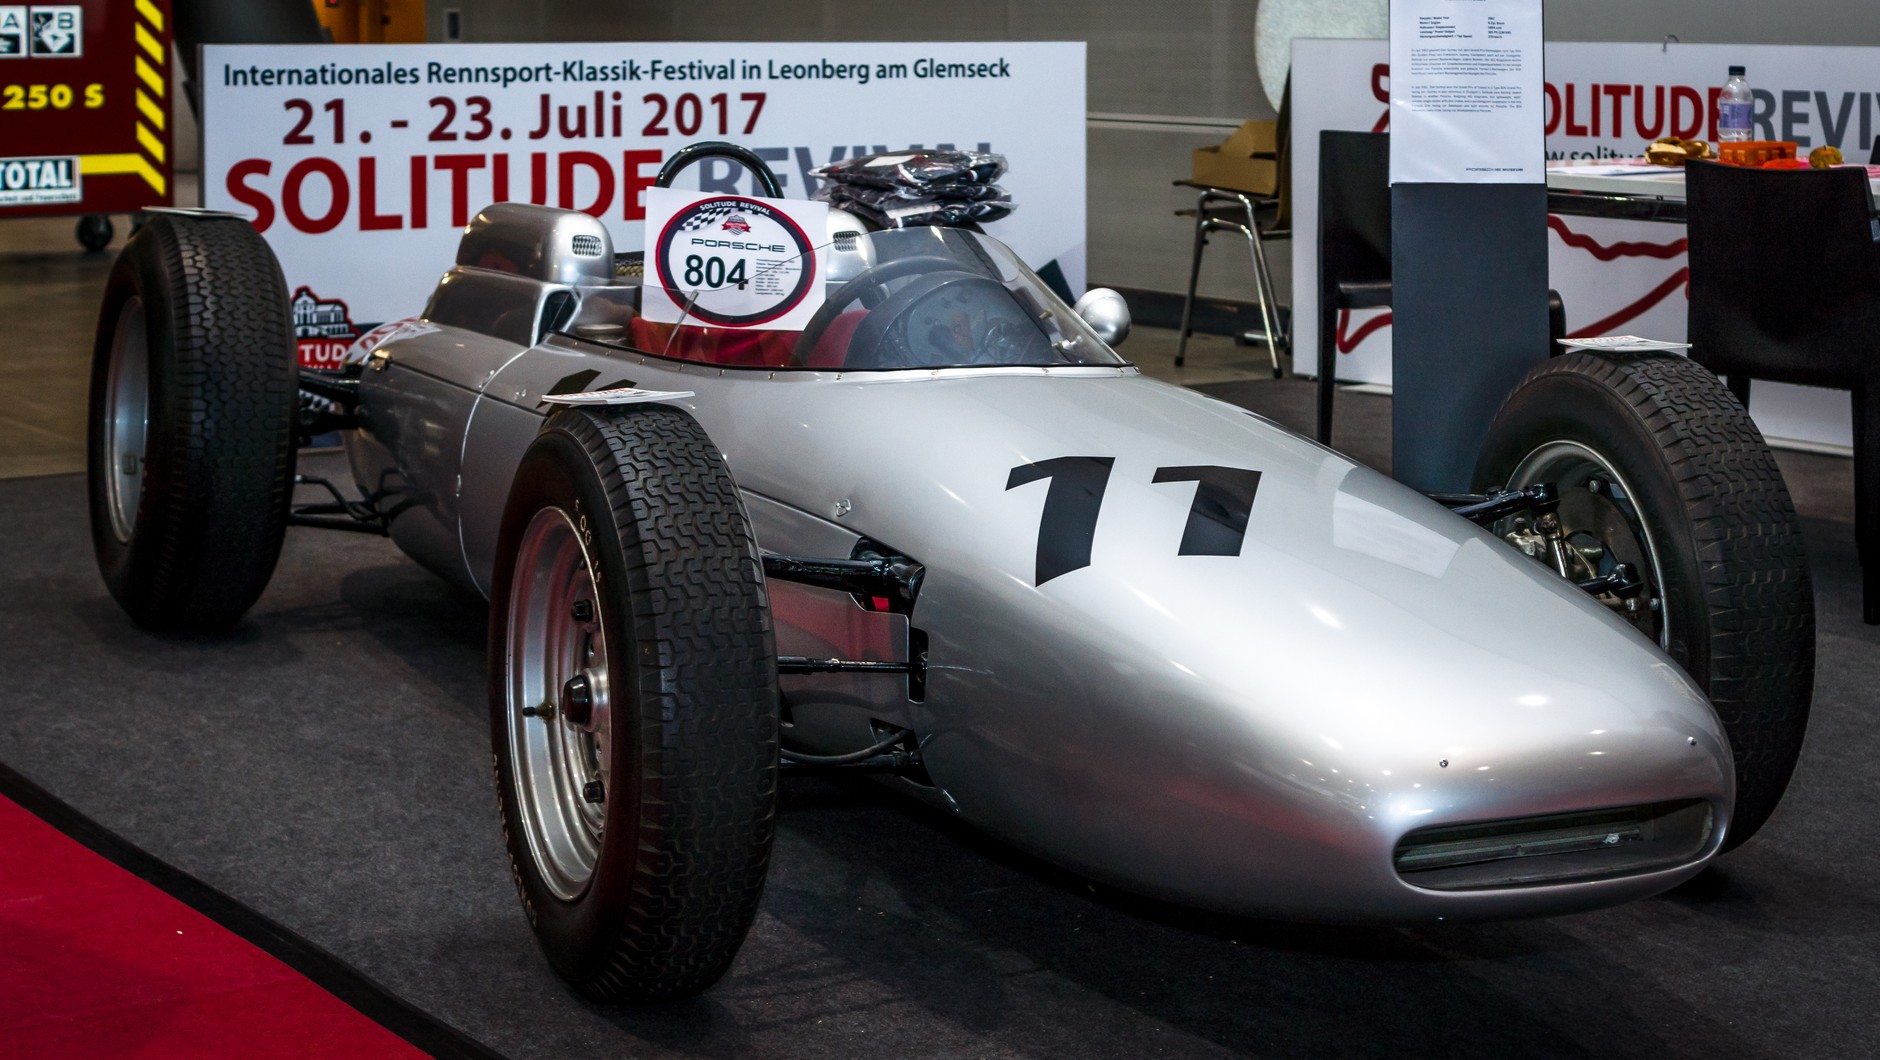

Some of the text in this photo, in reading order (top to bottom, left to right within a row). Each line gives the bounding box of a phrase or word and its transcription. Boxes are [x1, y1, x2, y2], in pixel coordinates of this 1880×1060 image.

[3, 13, 19, 28] A
[58, 12, 74, 29] B
[224, 58, 1010, 88] Internationales Rennsport-Klassik-Festival in Leonberg am Glemseck
[2, 83, 104, 109] 250 S
[283, 91, 767, 145] 21. - 23. Juli 2017
[1752, 88, 1880, 150] REVIV
[225, 149, 663, 234] SOLITUDE
[699, 201, 770, 215] SOLITUDE REVIVAL
[691, 238, 785, 253] PORSCHE
[684, 254, 748, 290] 804
[1005, 456, 1262, 588] 11
